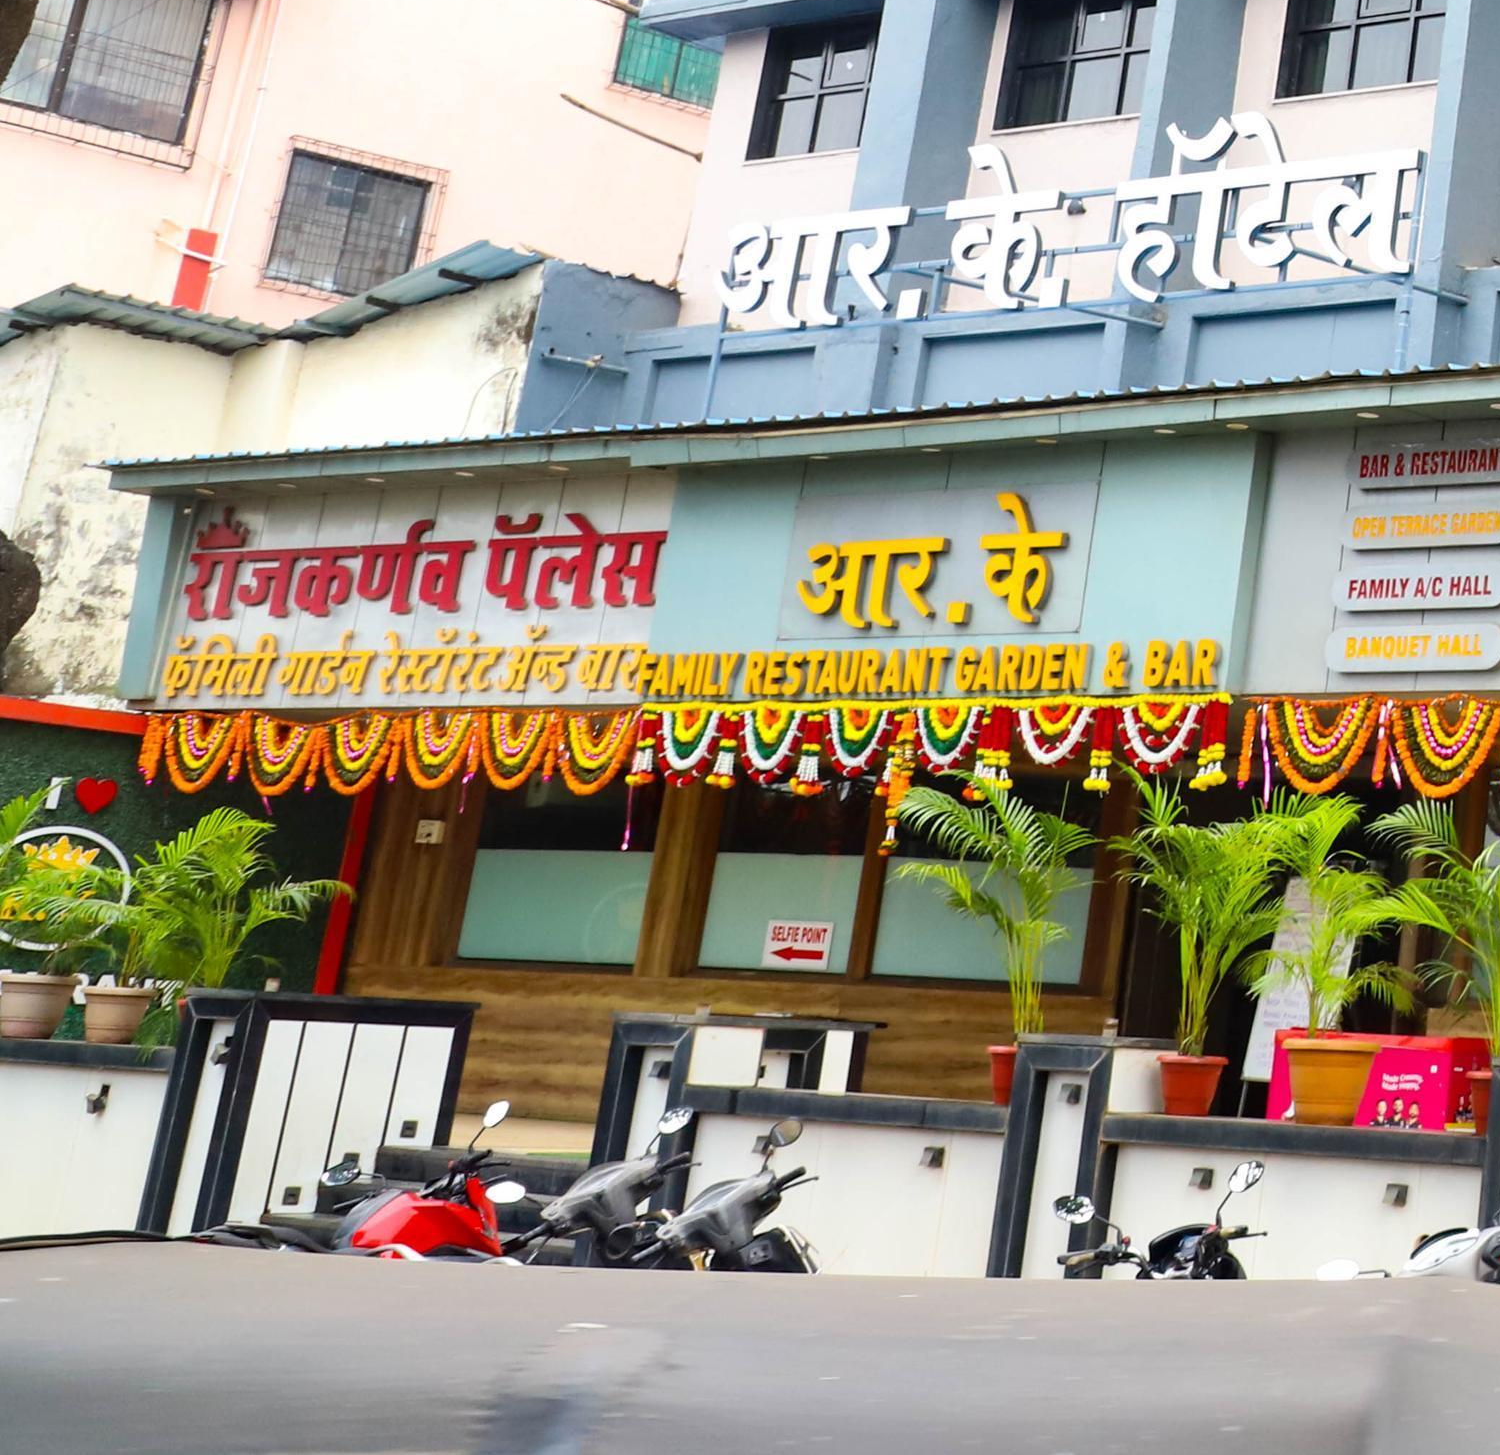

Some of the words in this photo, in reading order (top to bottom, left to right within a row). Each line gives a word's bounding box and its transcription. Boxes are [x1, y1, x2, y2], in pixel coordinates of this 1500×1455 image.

[713, 205, 927, 328] आर.
[946, 143, 1069, 310] के.
[1115, 110, 1427, 303] हॉटेल
[1360, 453, 1390, 478] BAR
[1394, 452, 1405, 477] &
[1351, 516, 1387, 539] OPEN
[1390, 514, 1449, 538] TERRACE
[184, 519, 476, 621] राजकर्णव
[486, 513, 668, 611] पॅलेस
[797, 536, 973, 630] आर.
[979, 492, 1070, 625] के
[1348, 577, 1411, 600] FAMILY
[1413, 576, 1444, 600] A/C
[1449, 575, 1493, 596] HALL
[278, 630, 376, 698] गार्डन
[576, 641, 648, 694] बार
[636, 651, 743, 696] FAMILY
[744, 647, 951, 696] RESTAURANT
[954, 644, 1091, 693] GARDEN
[1102, 641, 1132, 689] &
[1142, 639, 1220, 688] BAR
[1344, 634, 1432, 660] BANQUET
[1436, 633, 1483, 657] HALL
[771, 925, 800, 942] SELFIE
[801, 927, 828, 944] POINT
